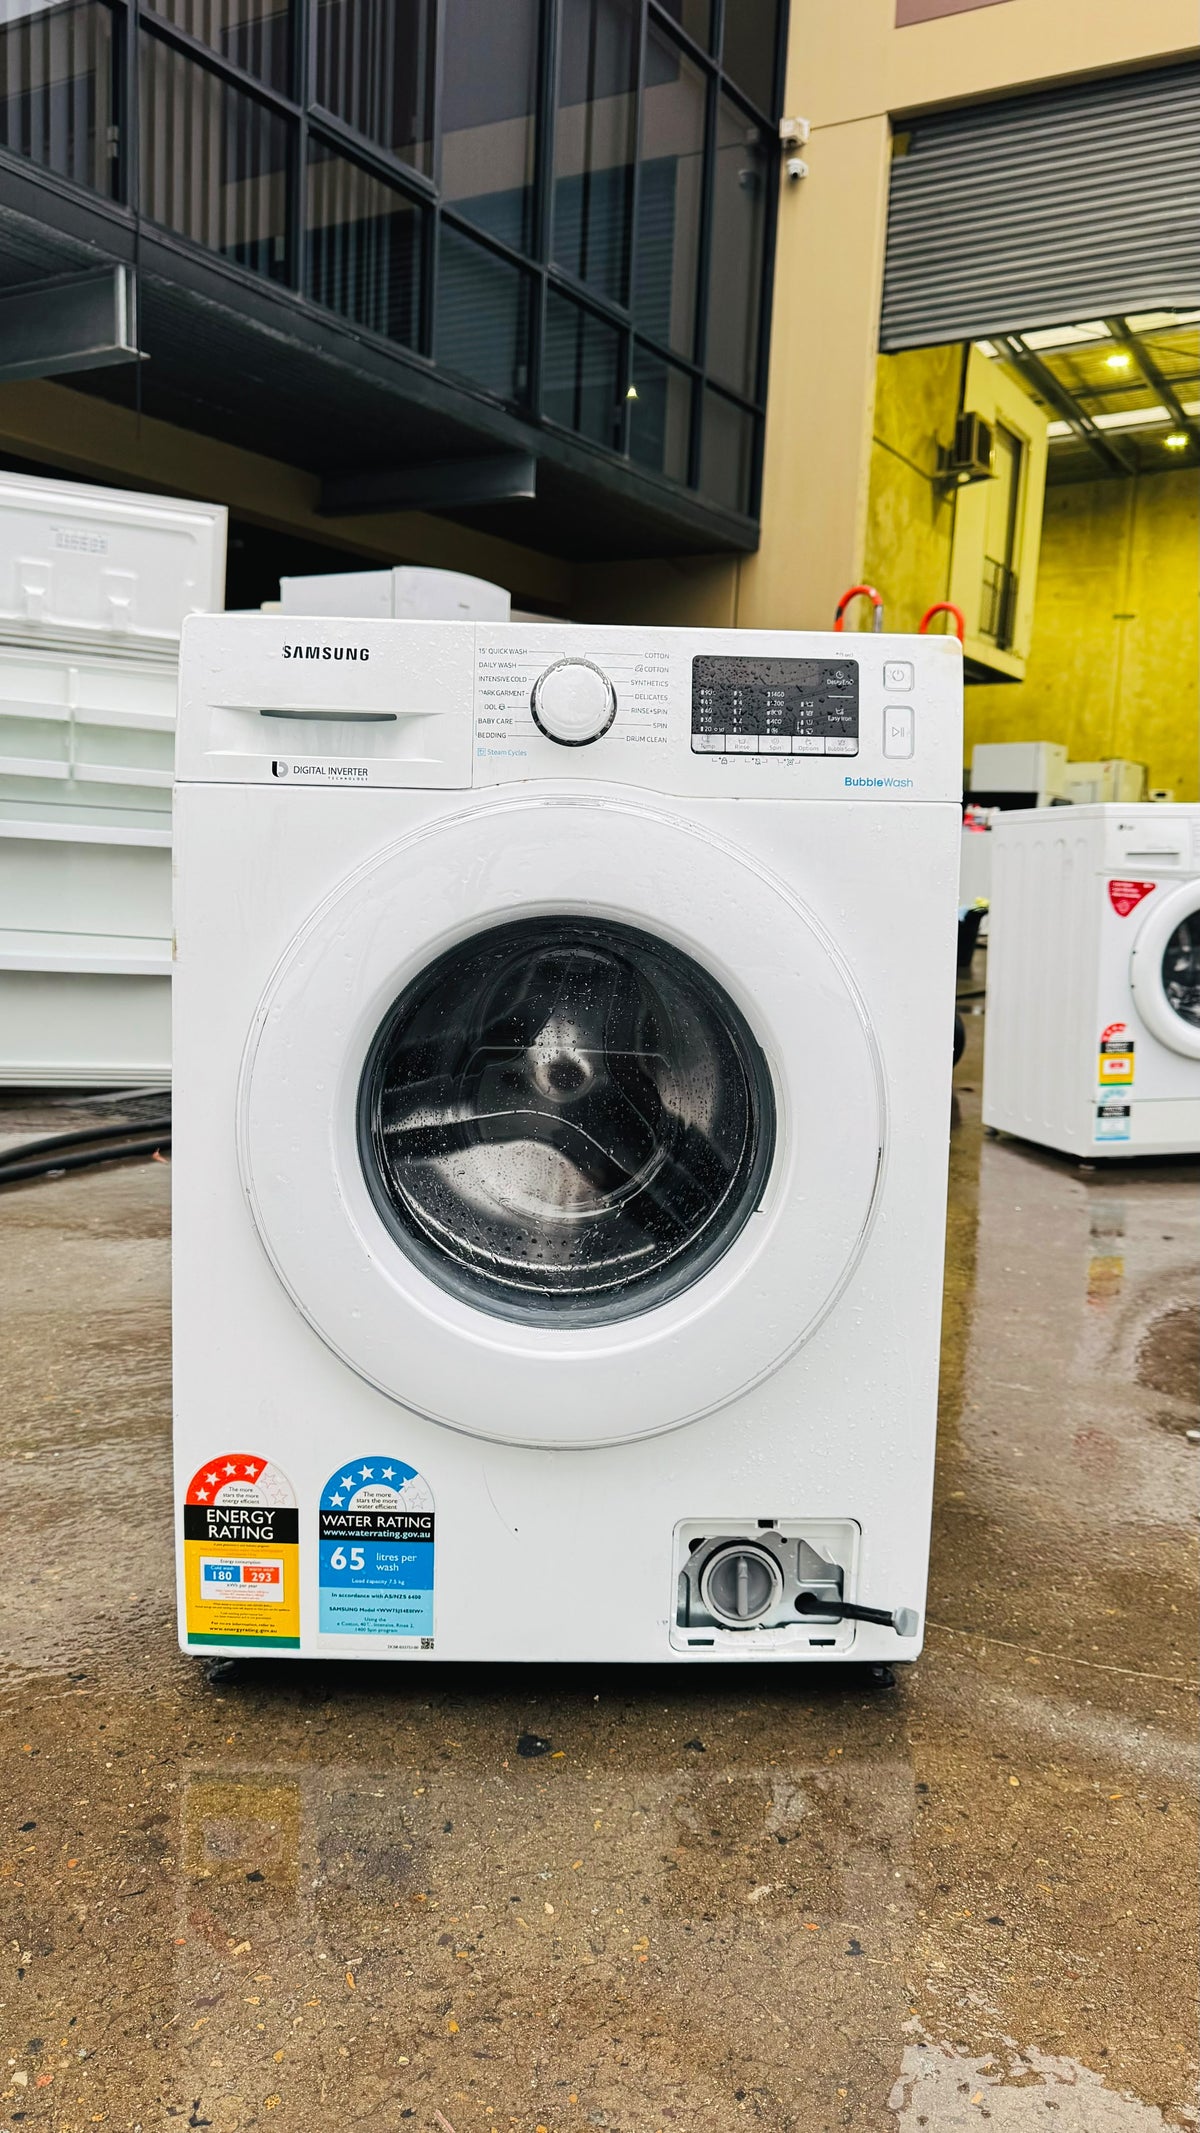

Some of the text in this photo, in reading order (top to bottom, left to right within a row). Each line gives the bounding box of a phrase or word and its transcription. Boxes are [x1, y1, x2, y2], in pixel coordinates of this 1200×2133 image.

[283, 645, 370, 661] SAMSUNG
[630, 679, 669, 687] SYNTHETICS
[634, 693, 668, 701] DELICATES
[293, 765, 368, 776] DIGITAL INVERTER
[844, 777, 913, 788] BubbleWash
[206, 1509, 276, 1524] ENERGY
[322, 1515, 431, 1529] WATER RATING
[208, 1525, 274, 1540] RATING
[323, 1529, 431, 1539] www.waterrating.gov.au
[330, 1546, 365, 1571] 65
[376, 1552, 417, 1564] litres per
[376, 1563, 399, 1572] wash
[212, 1571, 232, 1581] 180
[251, 1572, 272, 1582] 293
